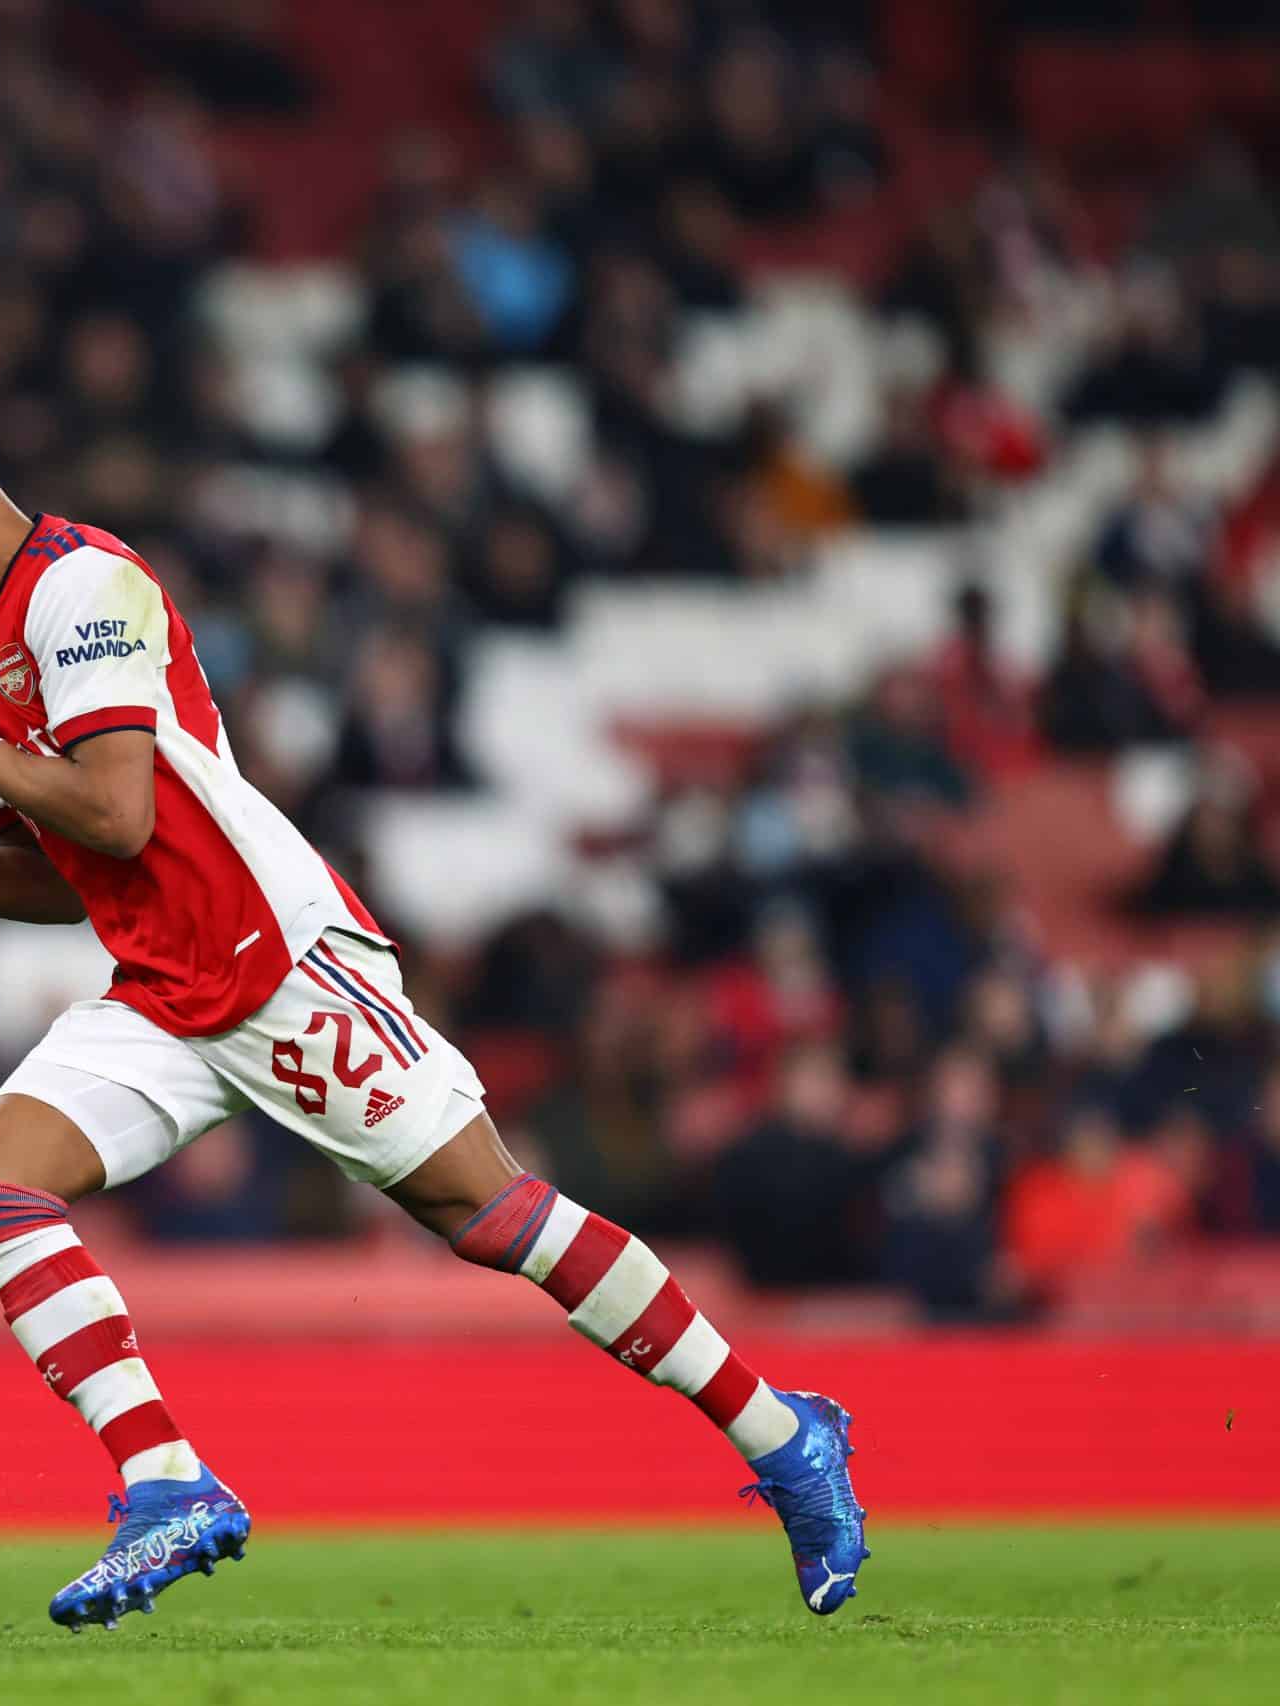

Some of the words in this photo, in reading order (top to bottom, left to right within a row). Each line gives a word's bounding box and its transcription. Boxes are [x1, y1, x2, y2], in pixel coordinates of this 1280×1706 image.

[74, 619, 128, 641] VISIT
[55, 637, 147, 668] RWANDA
[271, 1011, 383, 1115] 82
[364, 1095, 406, 1128] adidas
